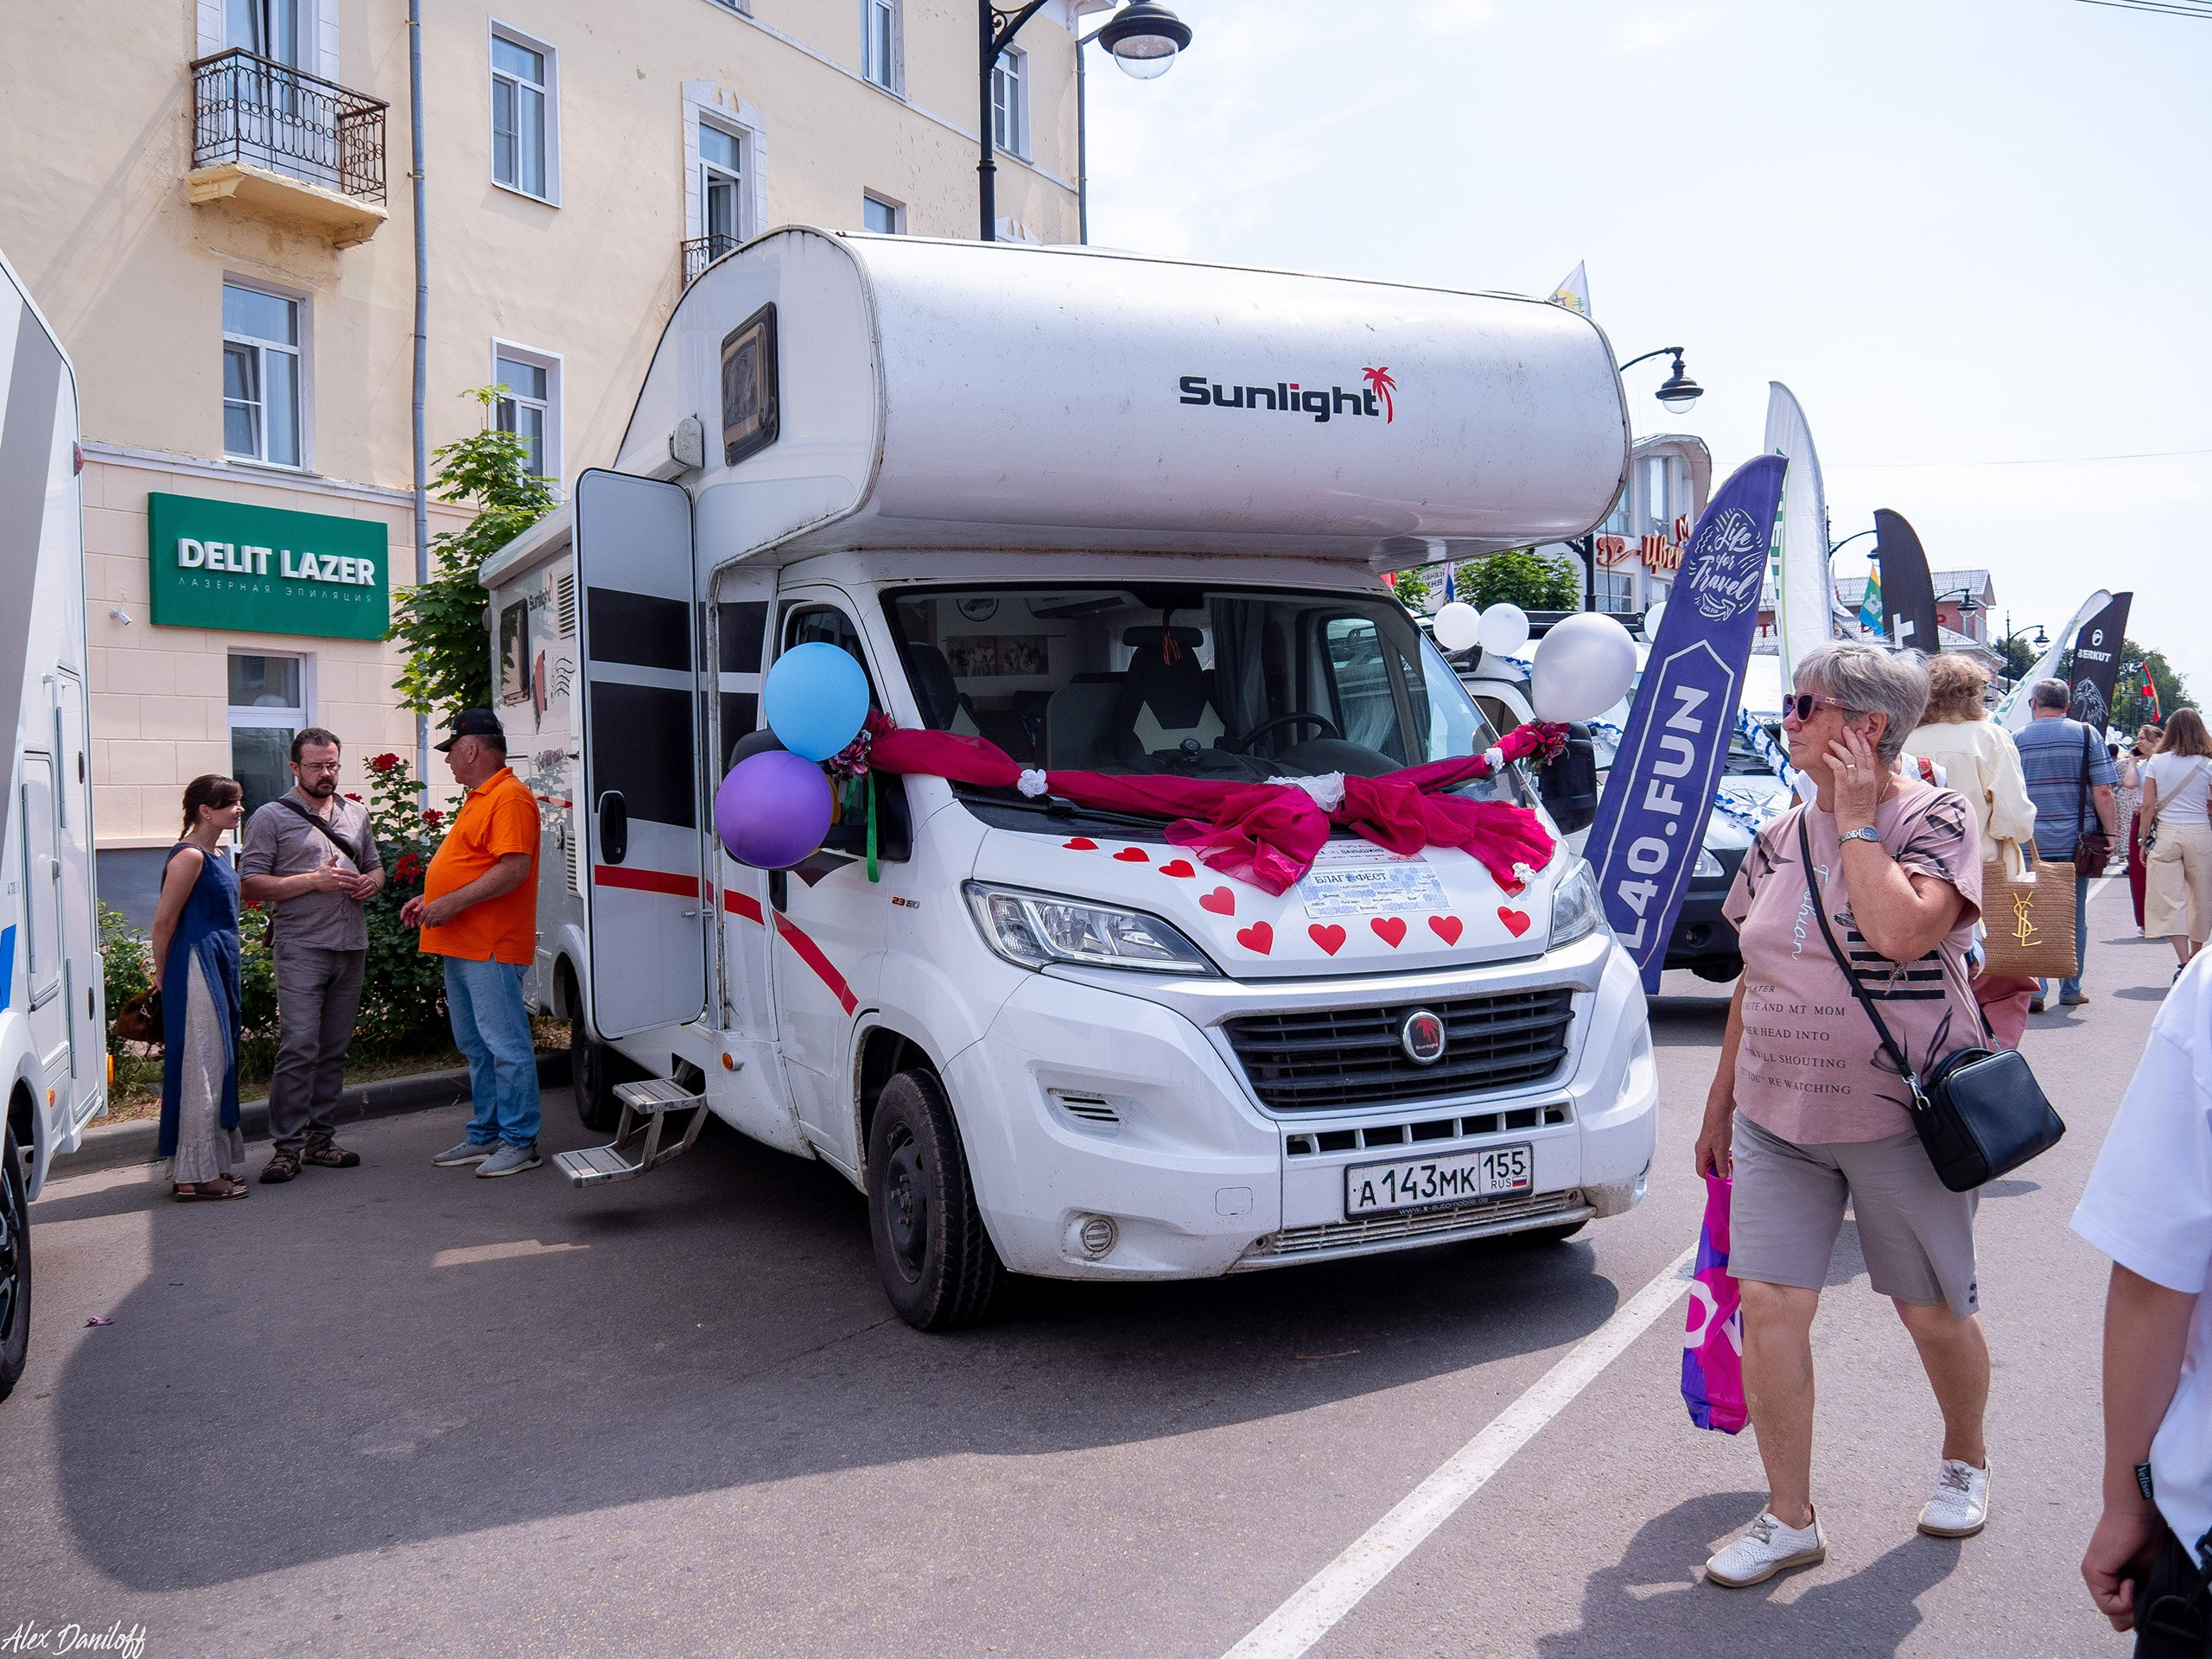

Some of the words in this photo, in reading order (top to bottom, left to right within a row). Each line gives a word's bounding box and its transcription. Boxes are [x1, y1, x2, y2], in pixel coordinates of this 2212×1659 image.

[1179, 375, 1380, 423] Sunlight
[1714, 512, 1752, 551] Life
[177, 537, 272, 575] DELIT
[280, 550, 376, 587] LAZER
[1716, 552, 1736, 570] for
[1690, 556, 1759, 601] Travel
[178, 577, 271, 594] ЛАЗЕРНАЯ
[285, 587, 372, 603] ЭПИЛЯЦИЯ
[2077, 649, 2112, 663] BERKUT
[1762, 1003, 1783, 1013] AND
[1815, 1006, 1846, 1016] MOM
[1761, 1027, 1791, 1039] HEAD
[1796, 1030, 1830, 1041] INTO
[1780, 1054, 1847, 1069] SHOUTING
[1784, 1079, 1851, 1095] WATCHING
[1483, 1150, 1524, 1179] 155
[1491, 1179, 1512, 1190] RUS
